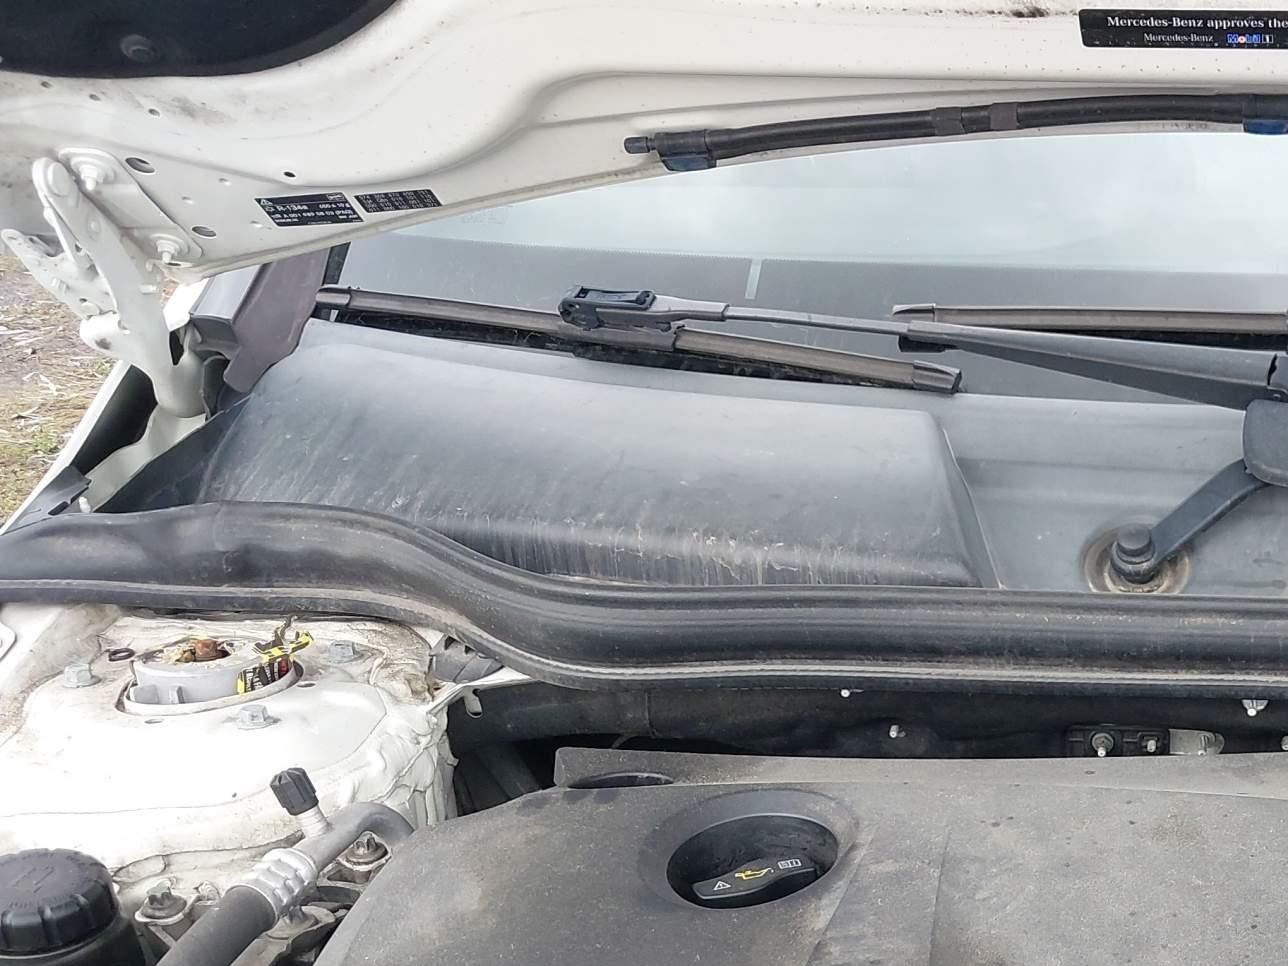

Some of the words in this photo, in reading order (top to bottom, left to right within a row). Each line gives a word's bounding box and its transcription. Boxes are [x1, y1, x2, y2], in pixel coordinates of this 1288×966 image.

[1107, 16, 1204, 27] Mercedes-Benz
[1207, 17, 1265, 30] approves
[1143, 33, 1214, 43] Mercedes-Benz
[1227, 33, 1261, 44] Mobil
